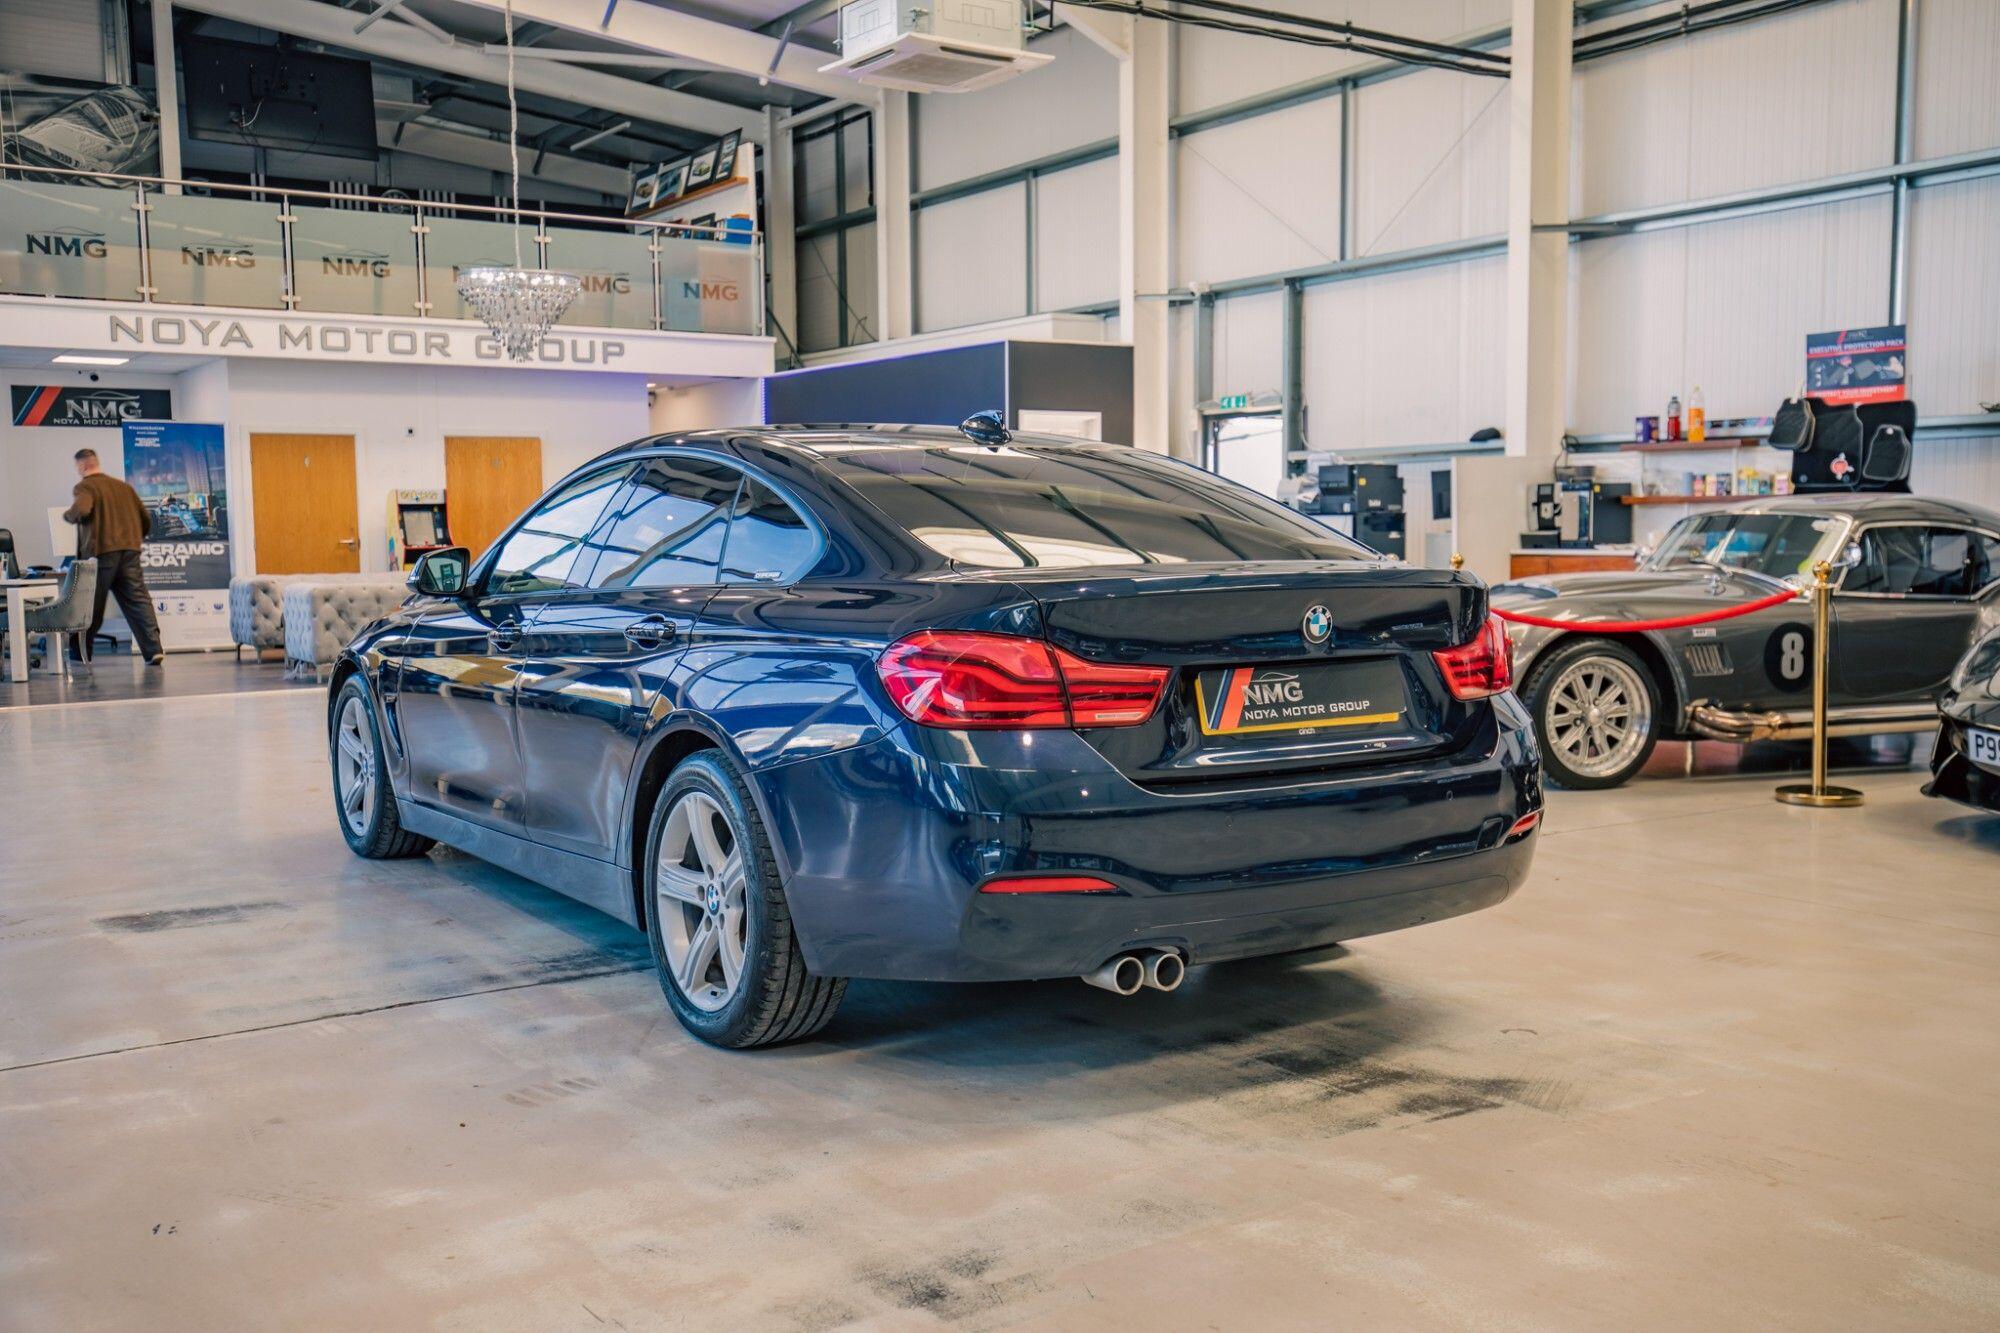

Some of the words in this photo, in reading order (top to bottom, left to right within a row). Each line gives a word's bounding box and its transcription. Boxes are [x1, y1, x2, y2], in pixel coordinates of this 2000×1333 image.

[26, 233, 107, 258] NMG
[182, 245, 256, 268] NMG
[322, 256, 391, 278] NMG
[684, 281, 737, 301] NMG
[110, 315, 253, 348] NOYA
[279, 324, 451, 358] MOTOR
[476, 335, 624, 363] GOUP
[65, 399, 141, 418] NMG
[1781, 632, 1805, 680] 8
[1242, 682, 1304, 706] NMG
[1245, 709, 1278, 720] NOYA
[1283, 704, 1325, 717] MOTOR
[1330, 700, 1370, 712] GROUP
[1975, 733, 2000, 761] P9
